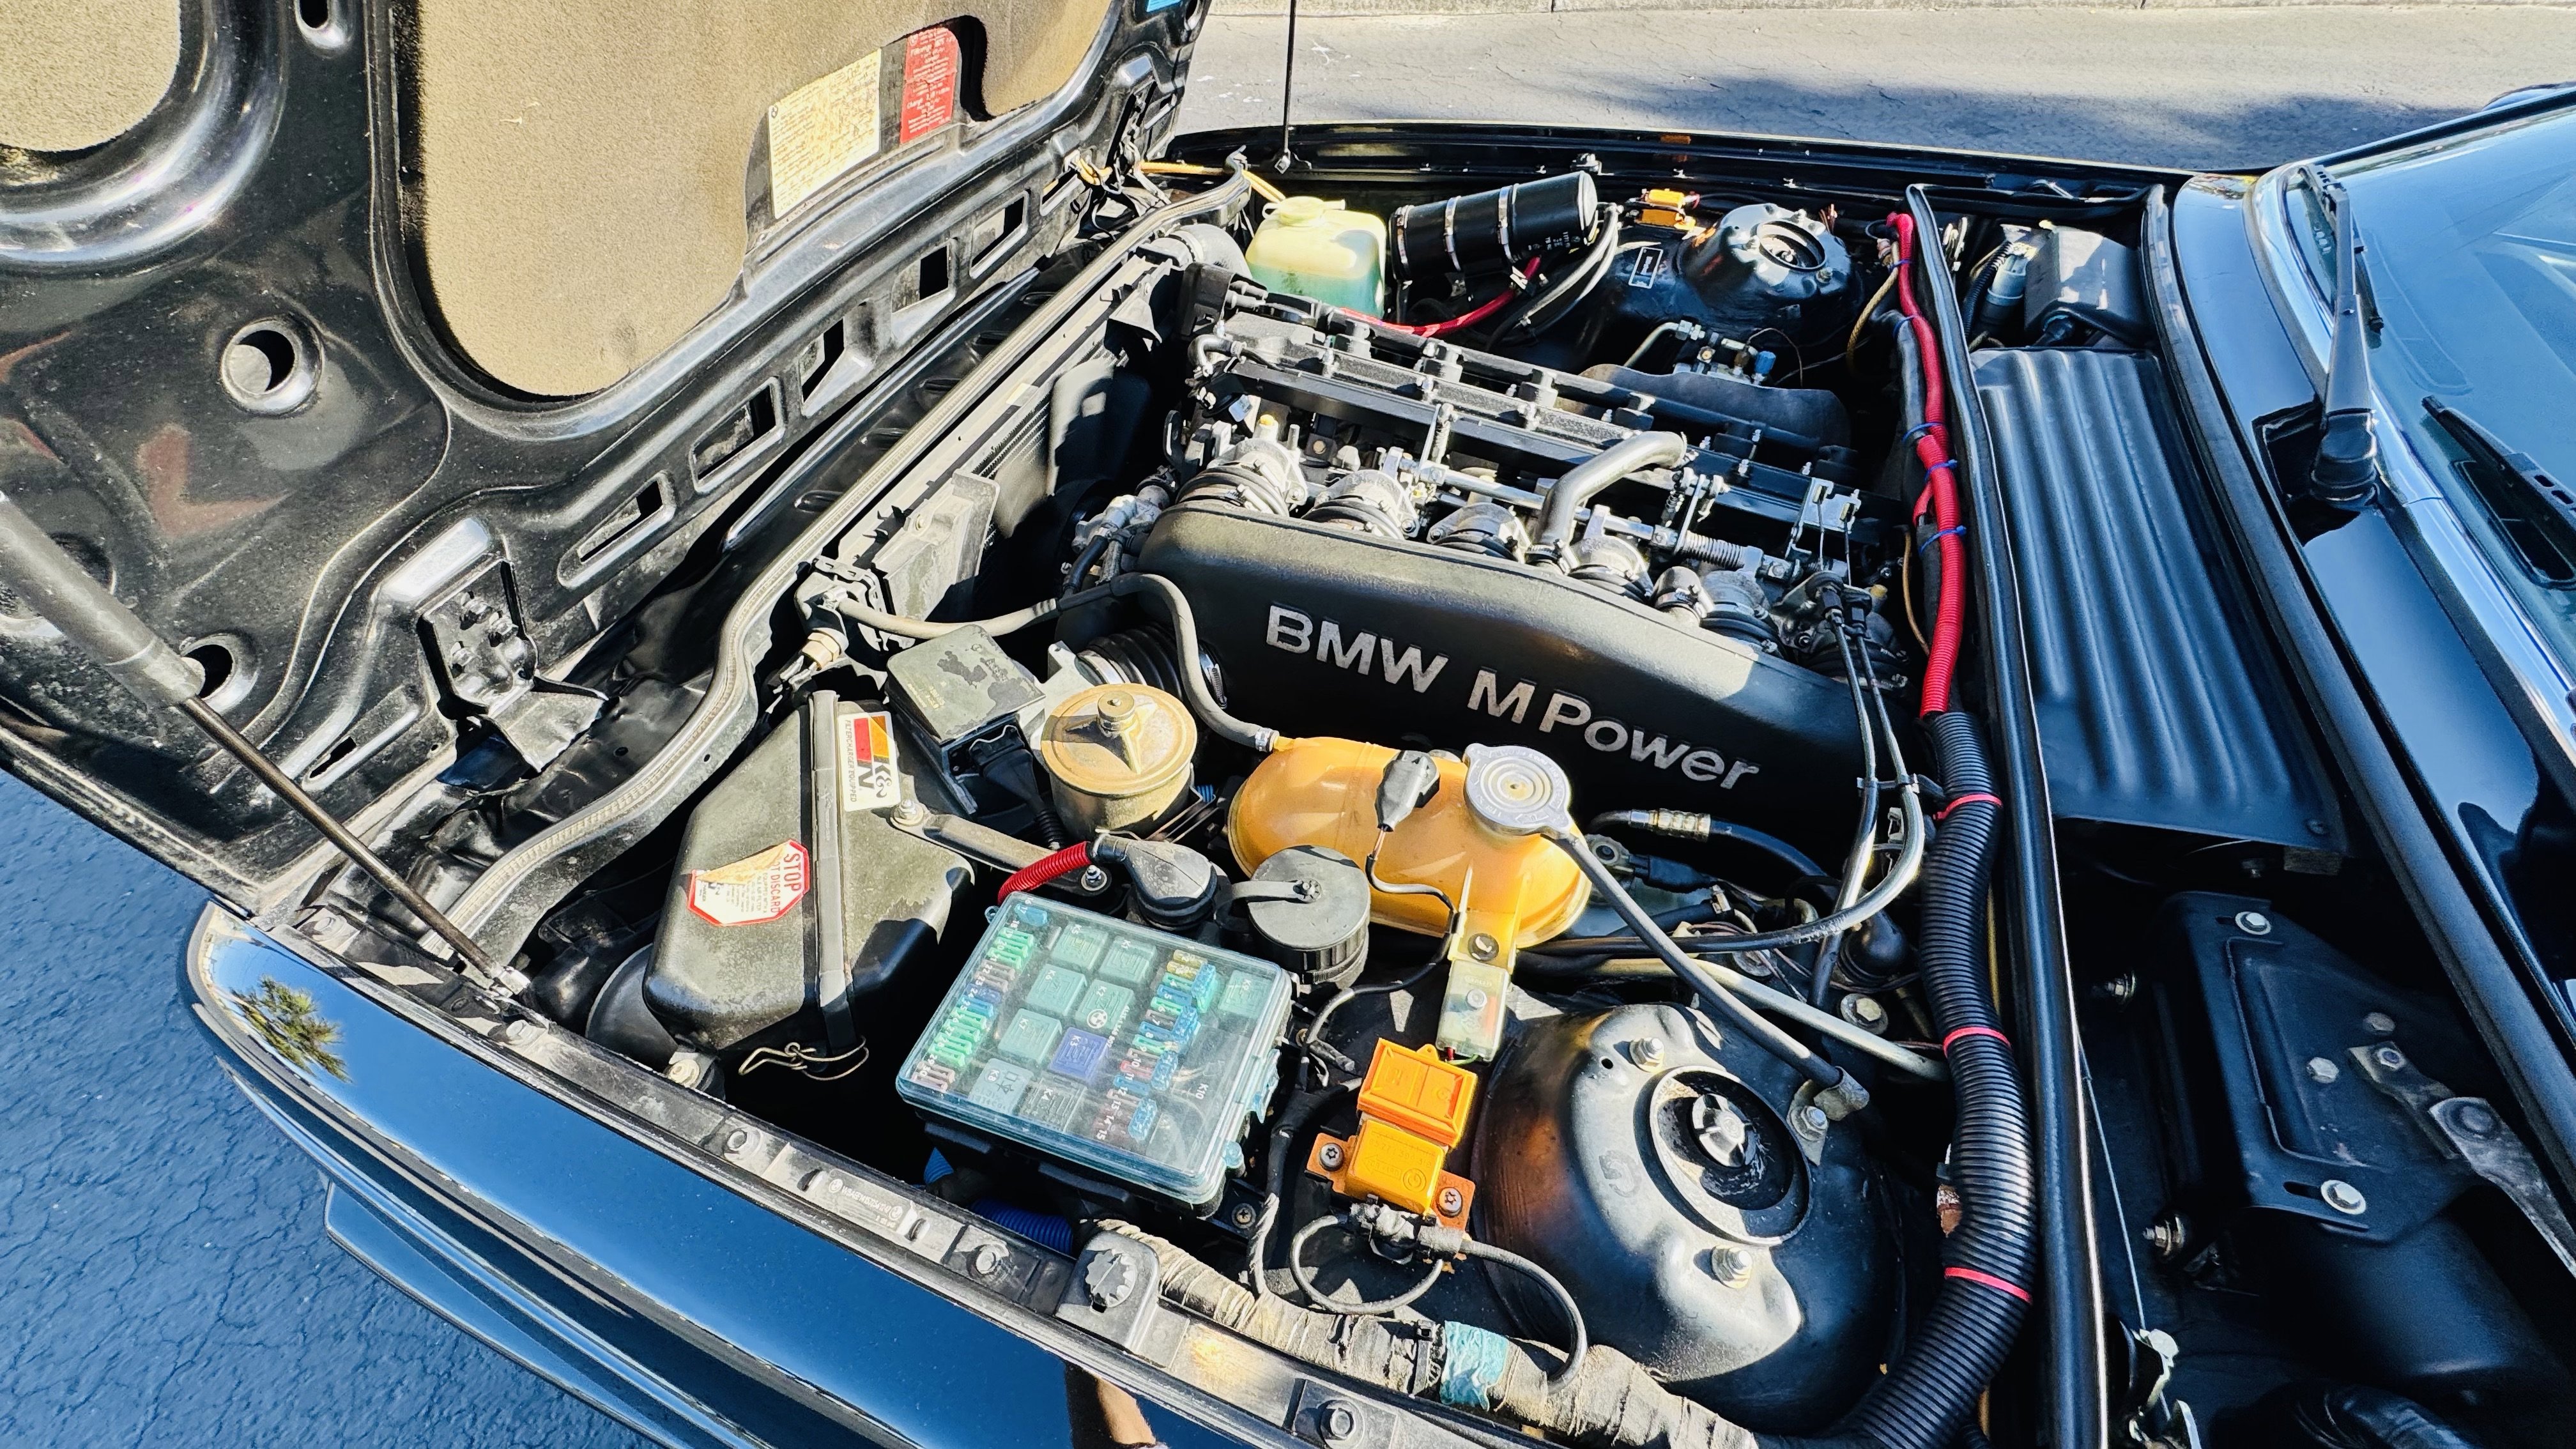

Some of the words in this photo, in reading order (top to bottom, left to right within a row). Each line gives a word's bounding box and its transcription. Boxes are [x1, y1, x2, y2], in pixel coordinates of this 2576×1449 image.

[1266, 604, 1449, 693] BMW
[845, 720, 854, 770] FILTERCHARGER
[848, 770, 857, 802] EQUIPPED
[784, 854, 801, 891] STOP
[770, 875, 781, 913] DISCARD
[983, 964, 993, 974] 22
[976, 976, 985, 986] 23
[969, 988, 978, 997] 24
[1096, 986, 1108, 997] K2
[960, 1001, 971, 1010] 25
[1152, 1016, 1160, 1025] 7
[1070, 1035, 1082, 1047] K3
[928, 1054, 937, 1064] 29
[1131, 1058, 1142, 1068] 10
[920, 1066, 931, 1077] 30
[988, 1070, 1000, 1082] K8
[1124, 1073, 1135, 1081] 11
[1041, 1088, 1054, 1100] K4
[1118, 1086, 1128, 1096] 12
[1195, 1083, 1209, 1100] K10
[1111, 1100, 1121, 1110] 13
[1104, 1115, 1115, 1126] 14
[1096, 1130, 1107, 1140] 15
